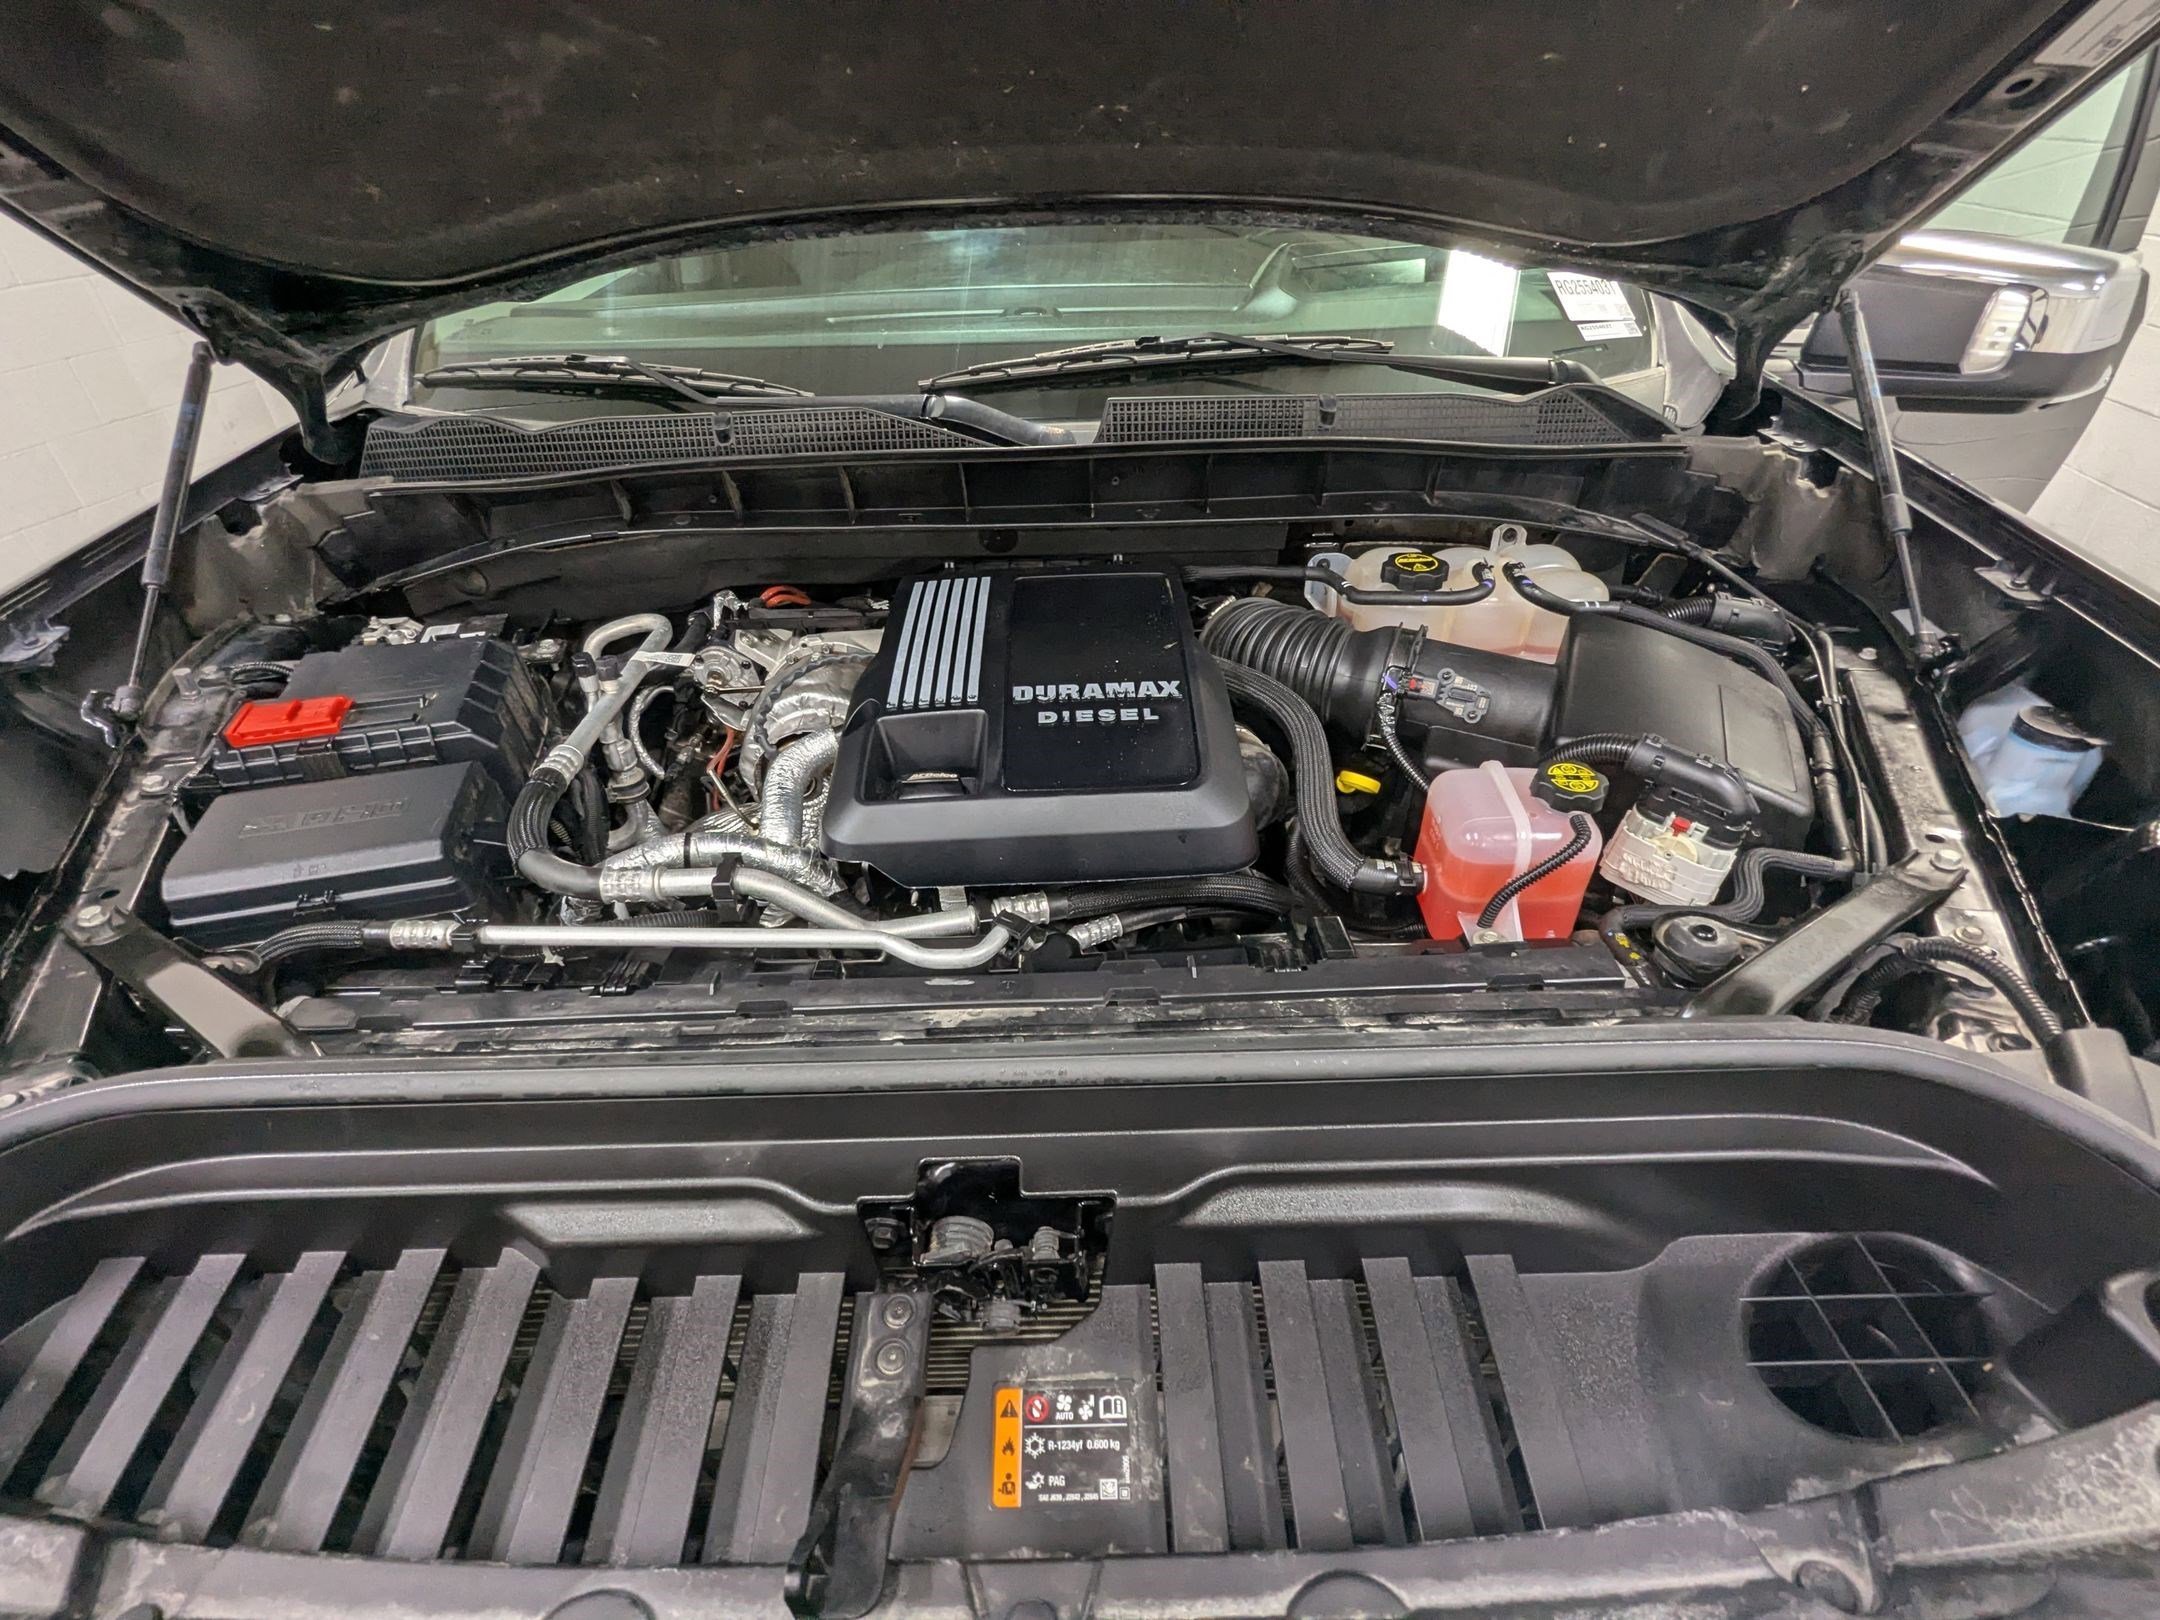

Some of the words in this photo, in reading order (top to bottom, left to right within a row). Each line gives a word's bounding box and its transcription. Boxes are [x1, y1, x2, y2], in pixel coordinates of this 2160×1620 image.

[1012, 680, 1183, 703] DURAMAX
[1037, 707, 1160, 725] DIESEL
[1055, 1411, 1074, 1421] AUTO
[1047, 1439, 1083, 1452] R-1234yf
[1086, 1439, 1109, 1450] 0.600
[1109, 1439, 1121, 1451] kg
[1048, 1475, 1066, 1487] PAG
